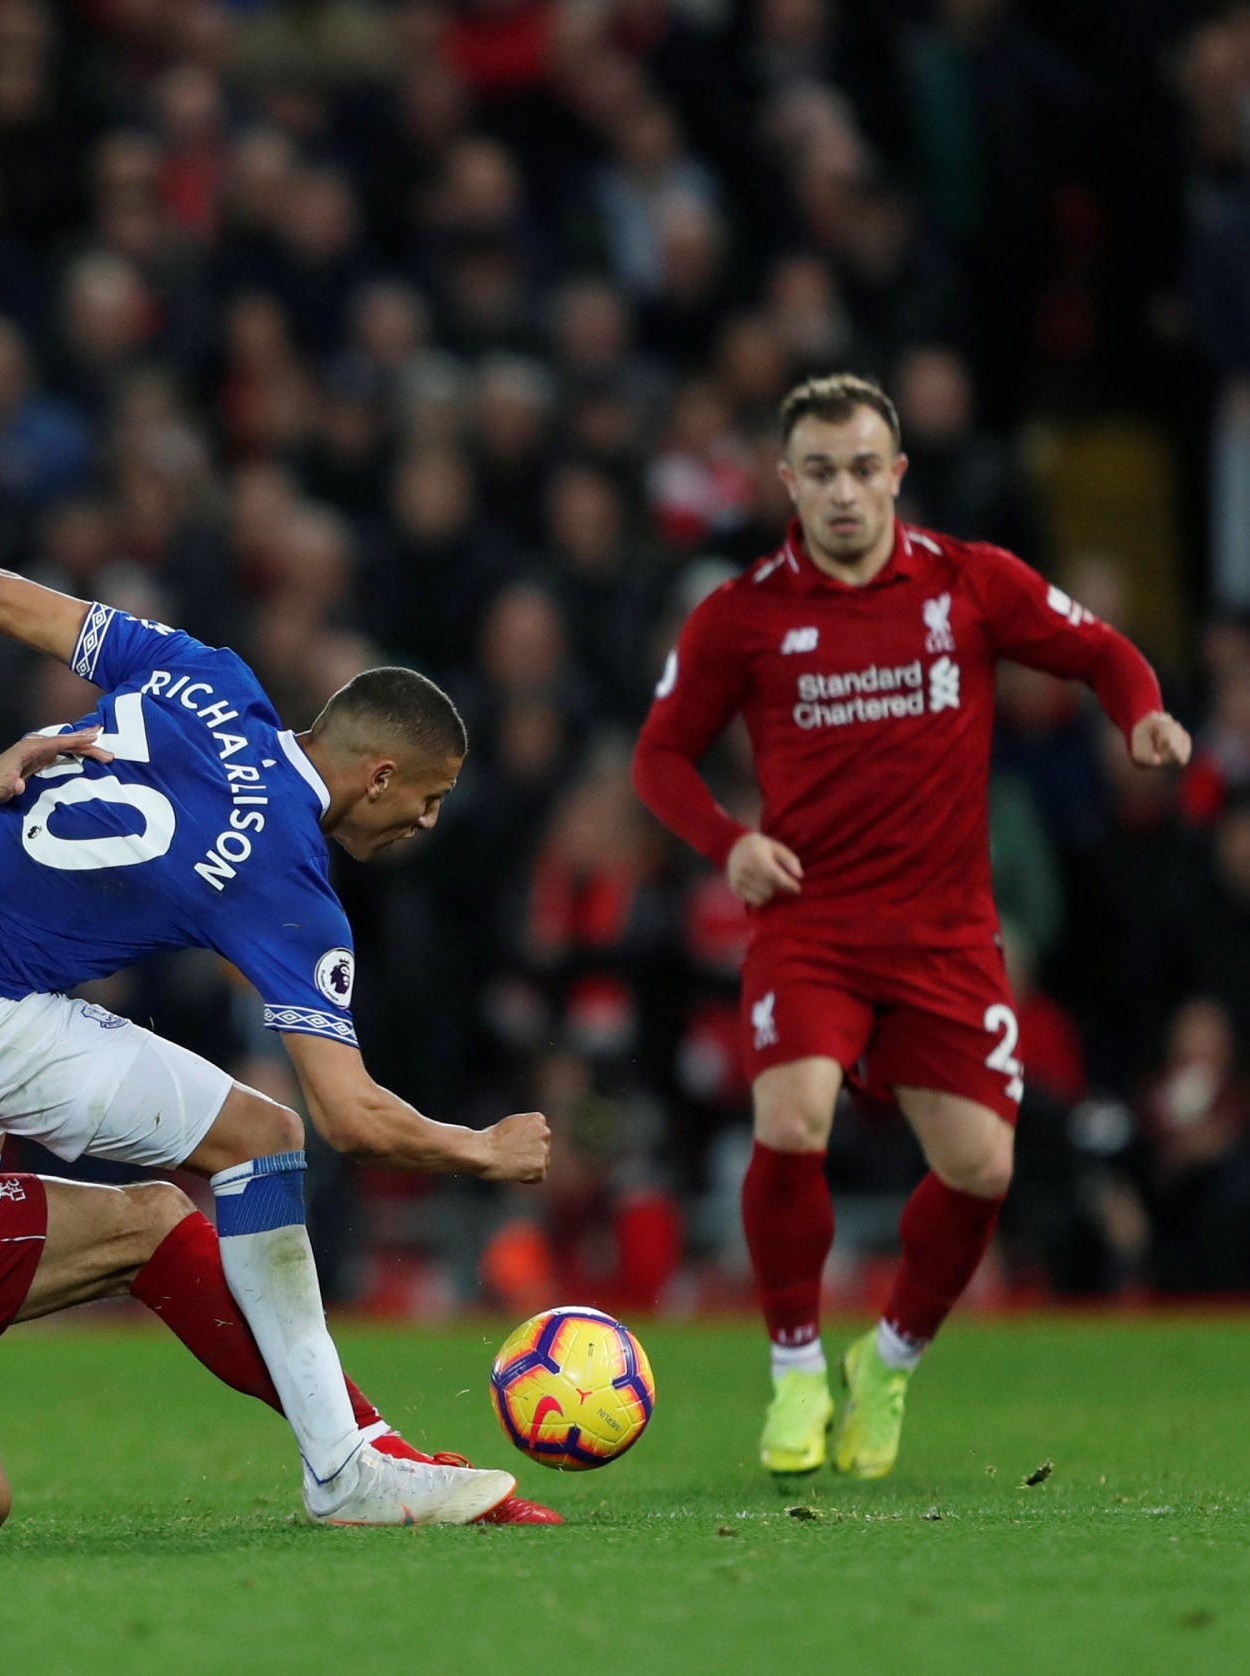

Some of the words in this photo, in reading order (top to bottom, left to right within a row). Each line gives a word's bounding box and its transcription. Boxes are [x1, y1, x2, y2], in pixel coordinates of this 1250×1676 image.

[797, 658, 923, 701] Standard
[792, 688, 924, 730] Chartered
[140, 670, 269, 892] RICHARLISON
